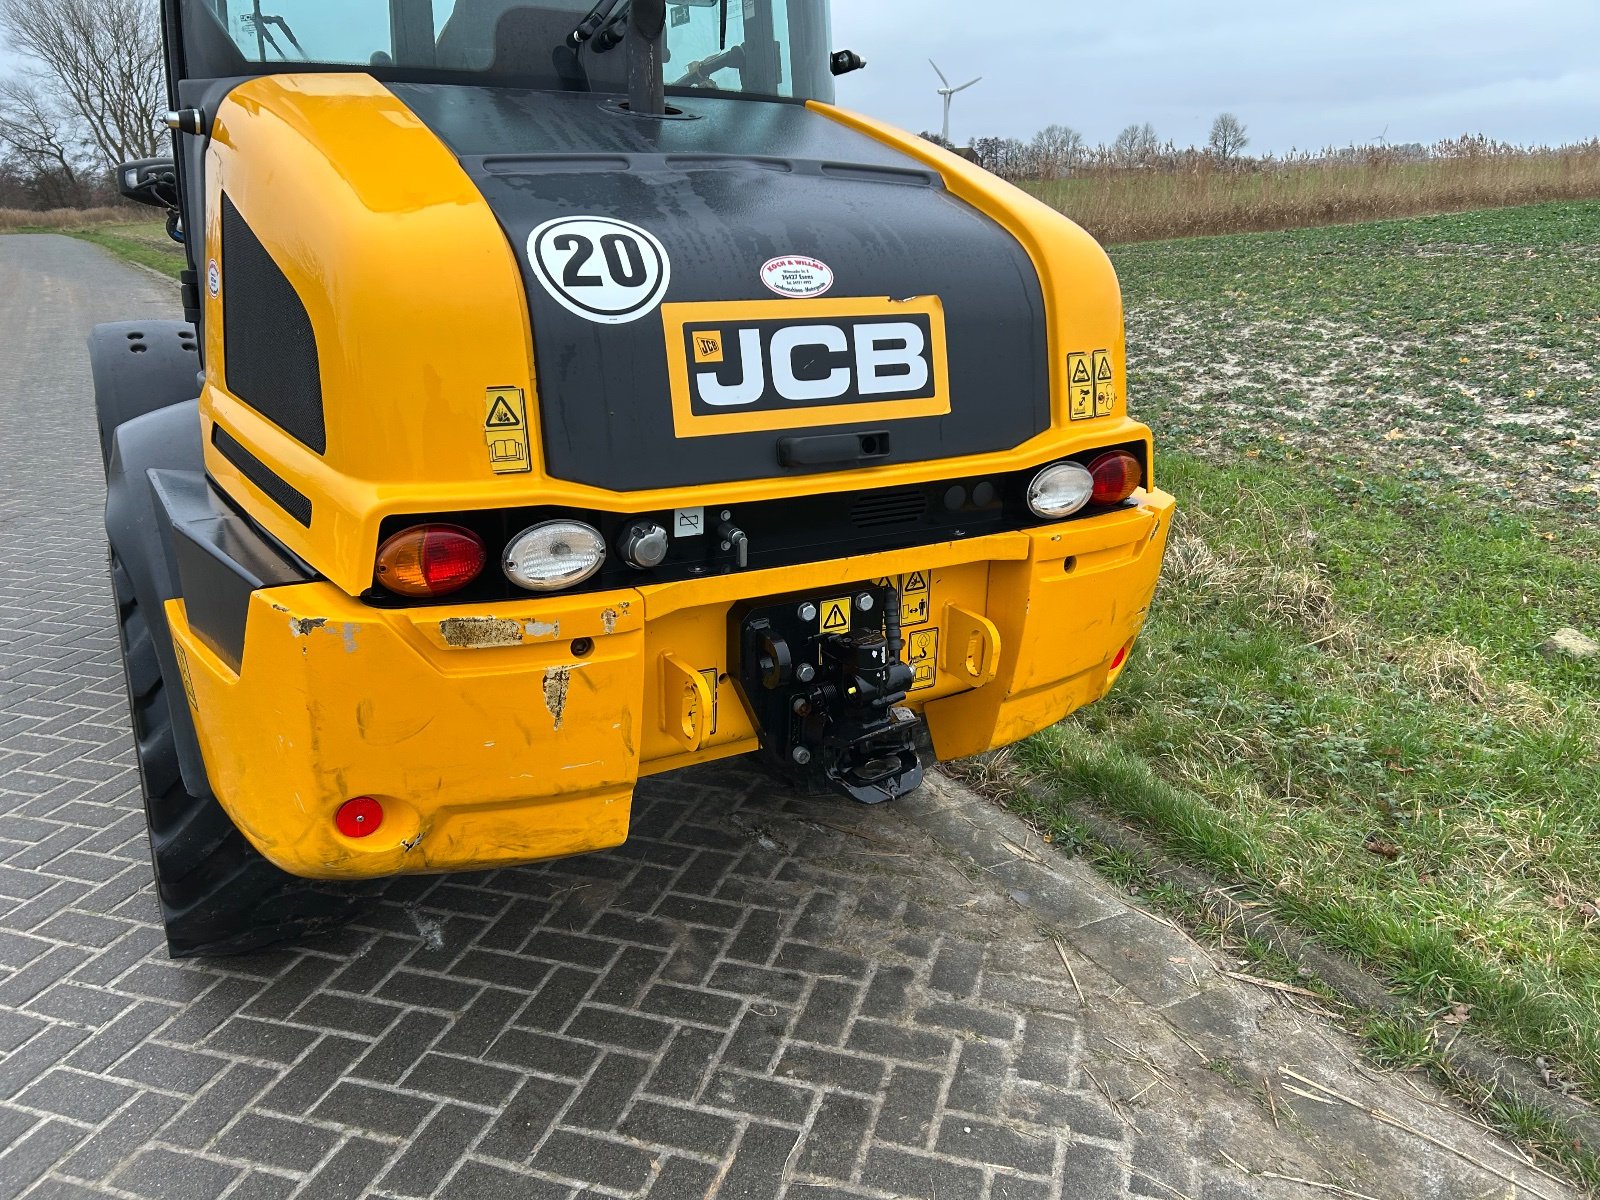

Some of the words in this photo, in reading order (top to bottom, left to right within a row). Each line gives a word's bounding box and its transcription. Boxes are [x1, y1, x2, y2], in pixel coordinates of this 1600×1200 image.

[553, 233, 648, 288] 20
[767, 260, 786, 272] KOCH
[696, 321, 929, 406] JCB
[700, 339, 718, 354] JCB
